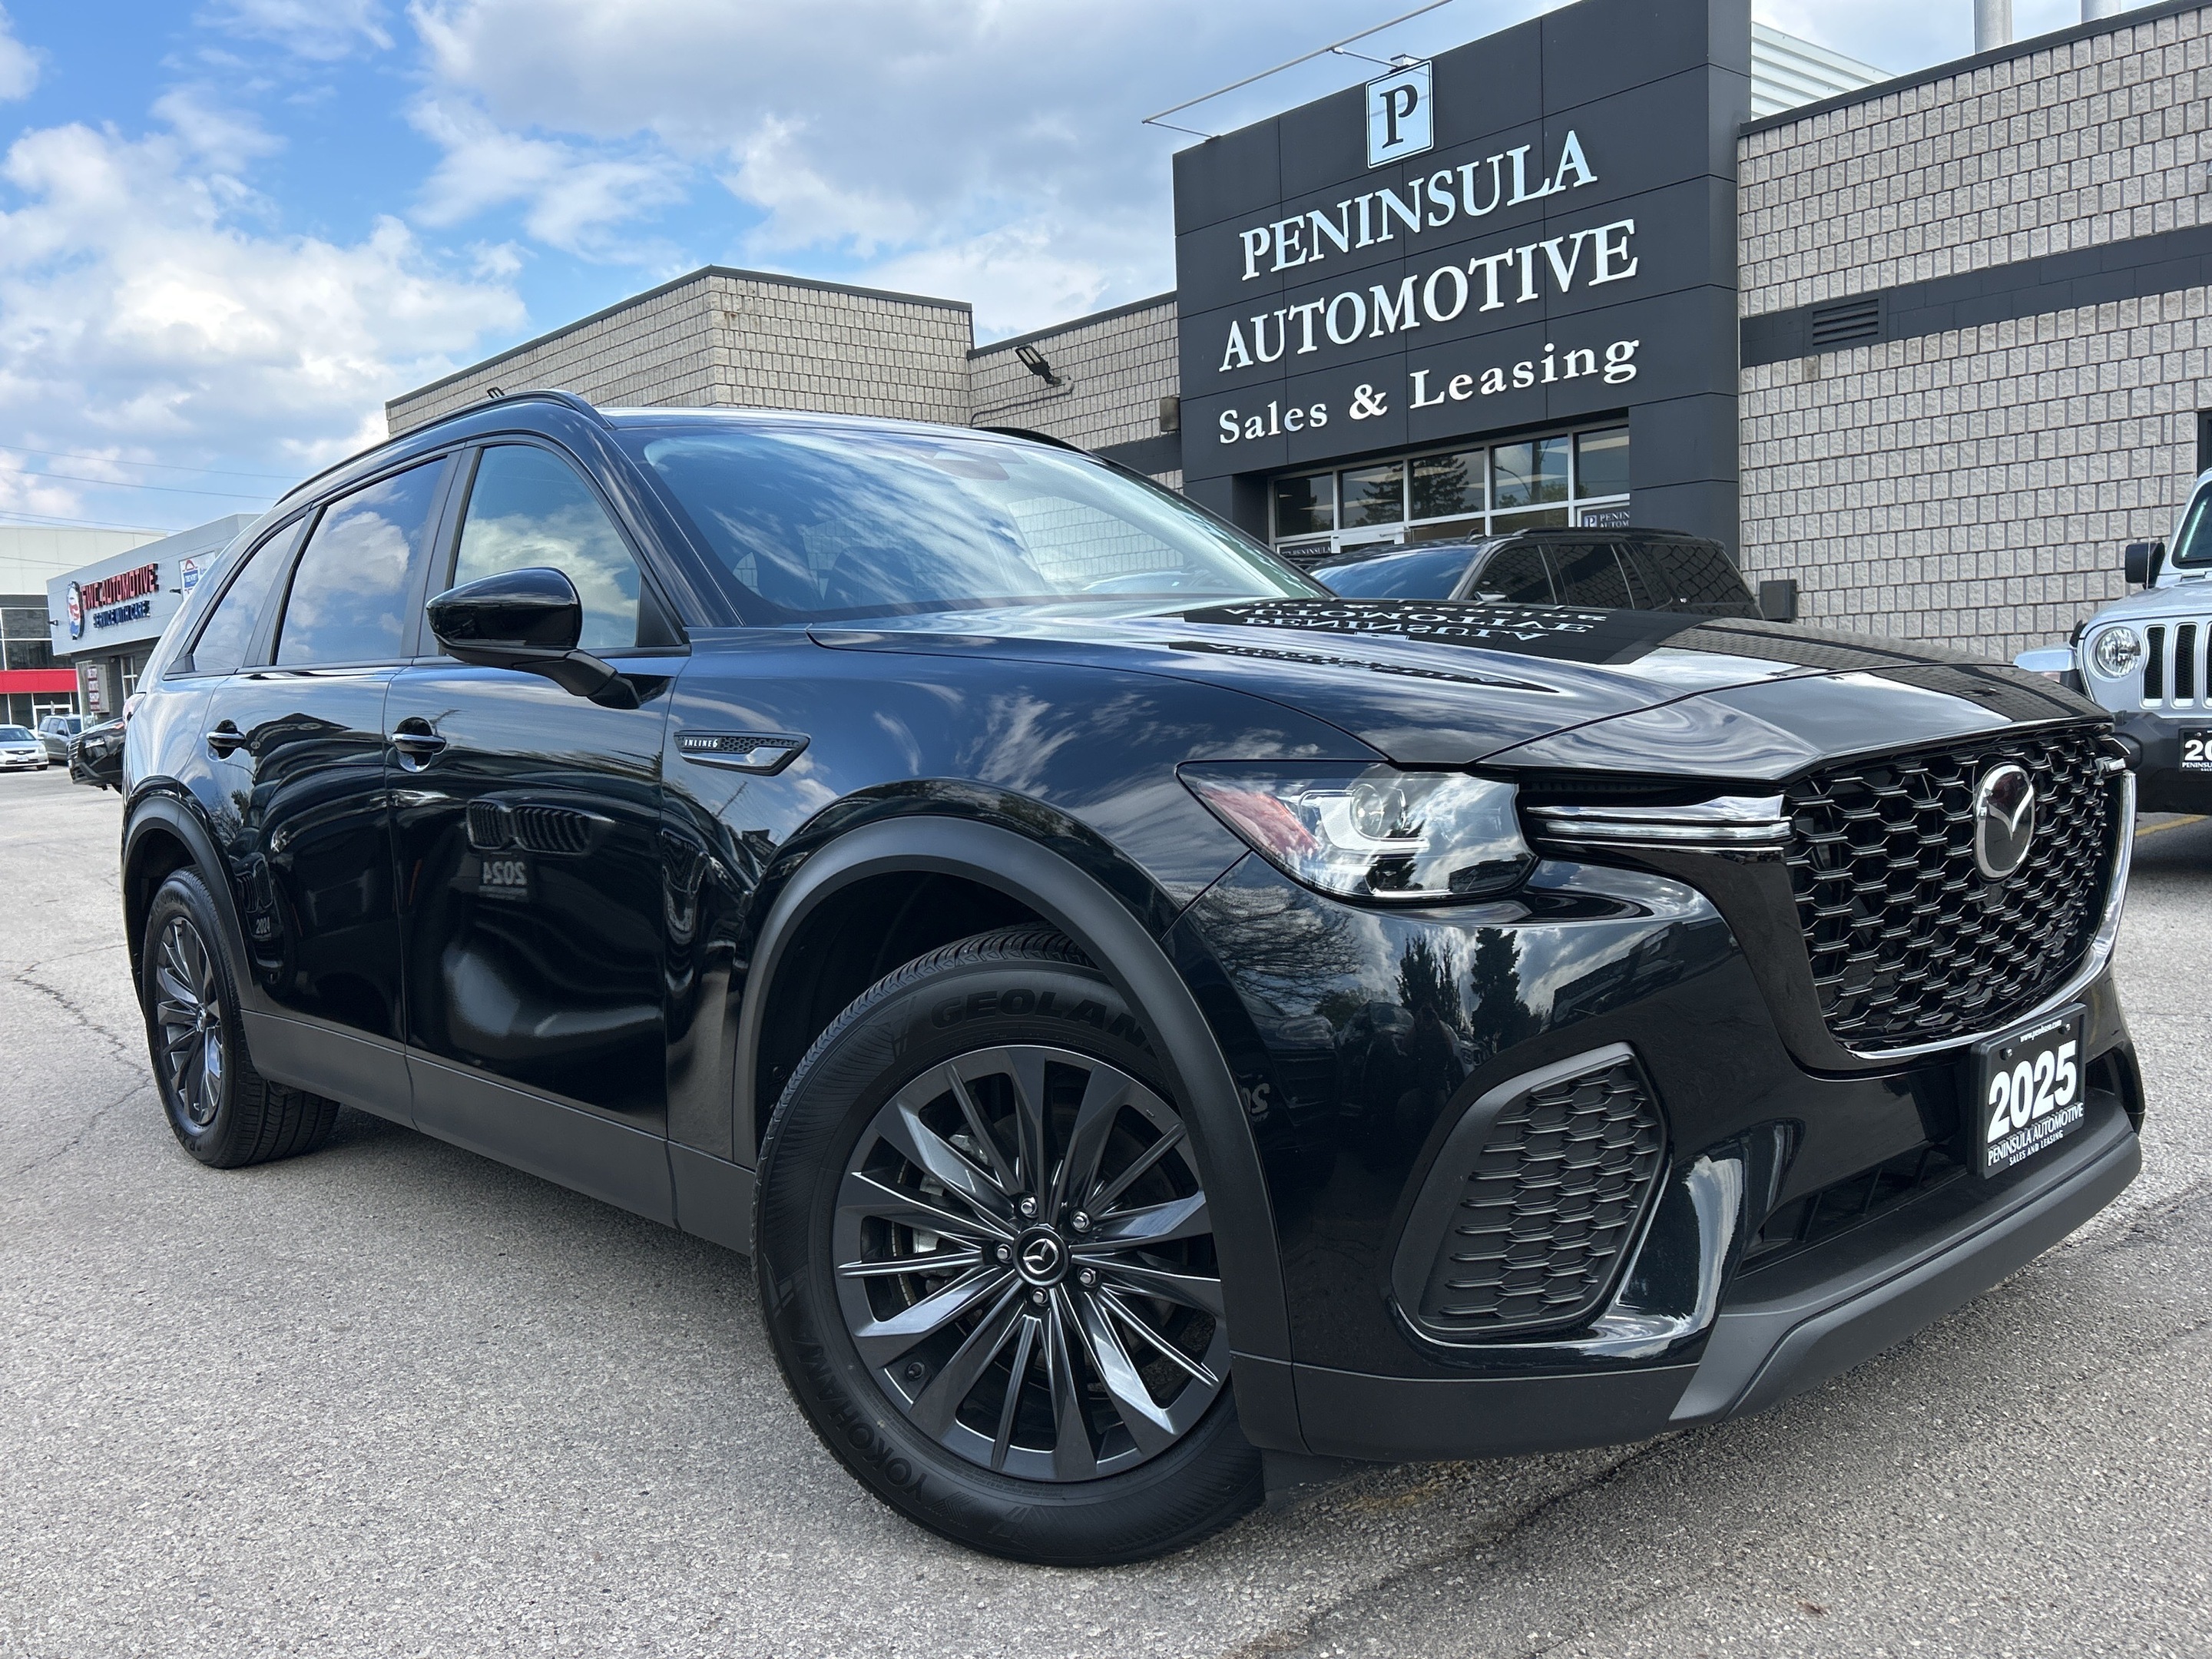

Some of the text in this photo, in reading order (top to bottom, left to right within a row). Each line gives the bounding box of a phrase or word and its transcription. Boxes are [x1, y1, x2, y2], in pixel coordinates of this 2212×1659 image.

[1380, 83, 1419, 149] P
[1240, 129, 1598, 282] PENINSULA
[1218, 218, 1640, 373] AUTOMOTIVE
[1218, 339, 1641, 445] Sales & Leasing
[100, 564, 159, 605] AUTOMOTIVE
[931, 988, 1157, 1059] GEOLAN
[1987, 1039, 2077, 1144] 2025
[1987, 1101, 2085, 1167] PENINSULA AUTOMOTIVE
[2008, 1129, 2065, 1167] SALES AND LEASING
